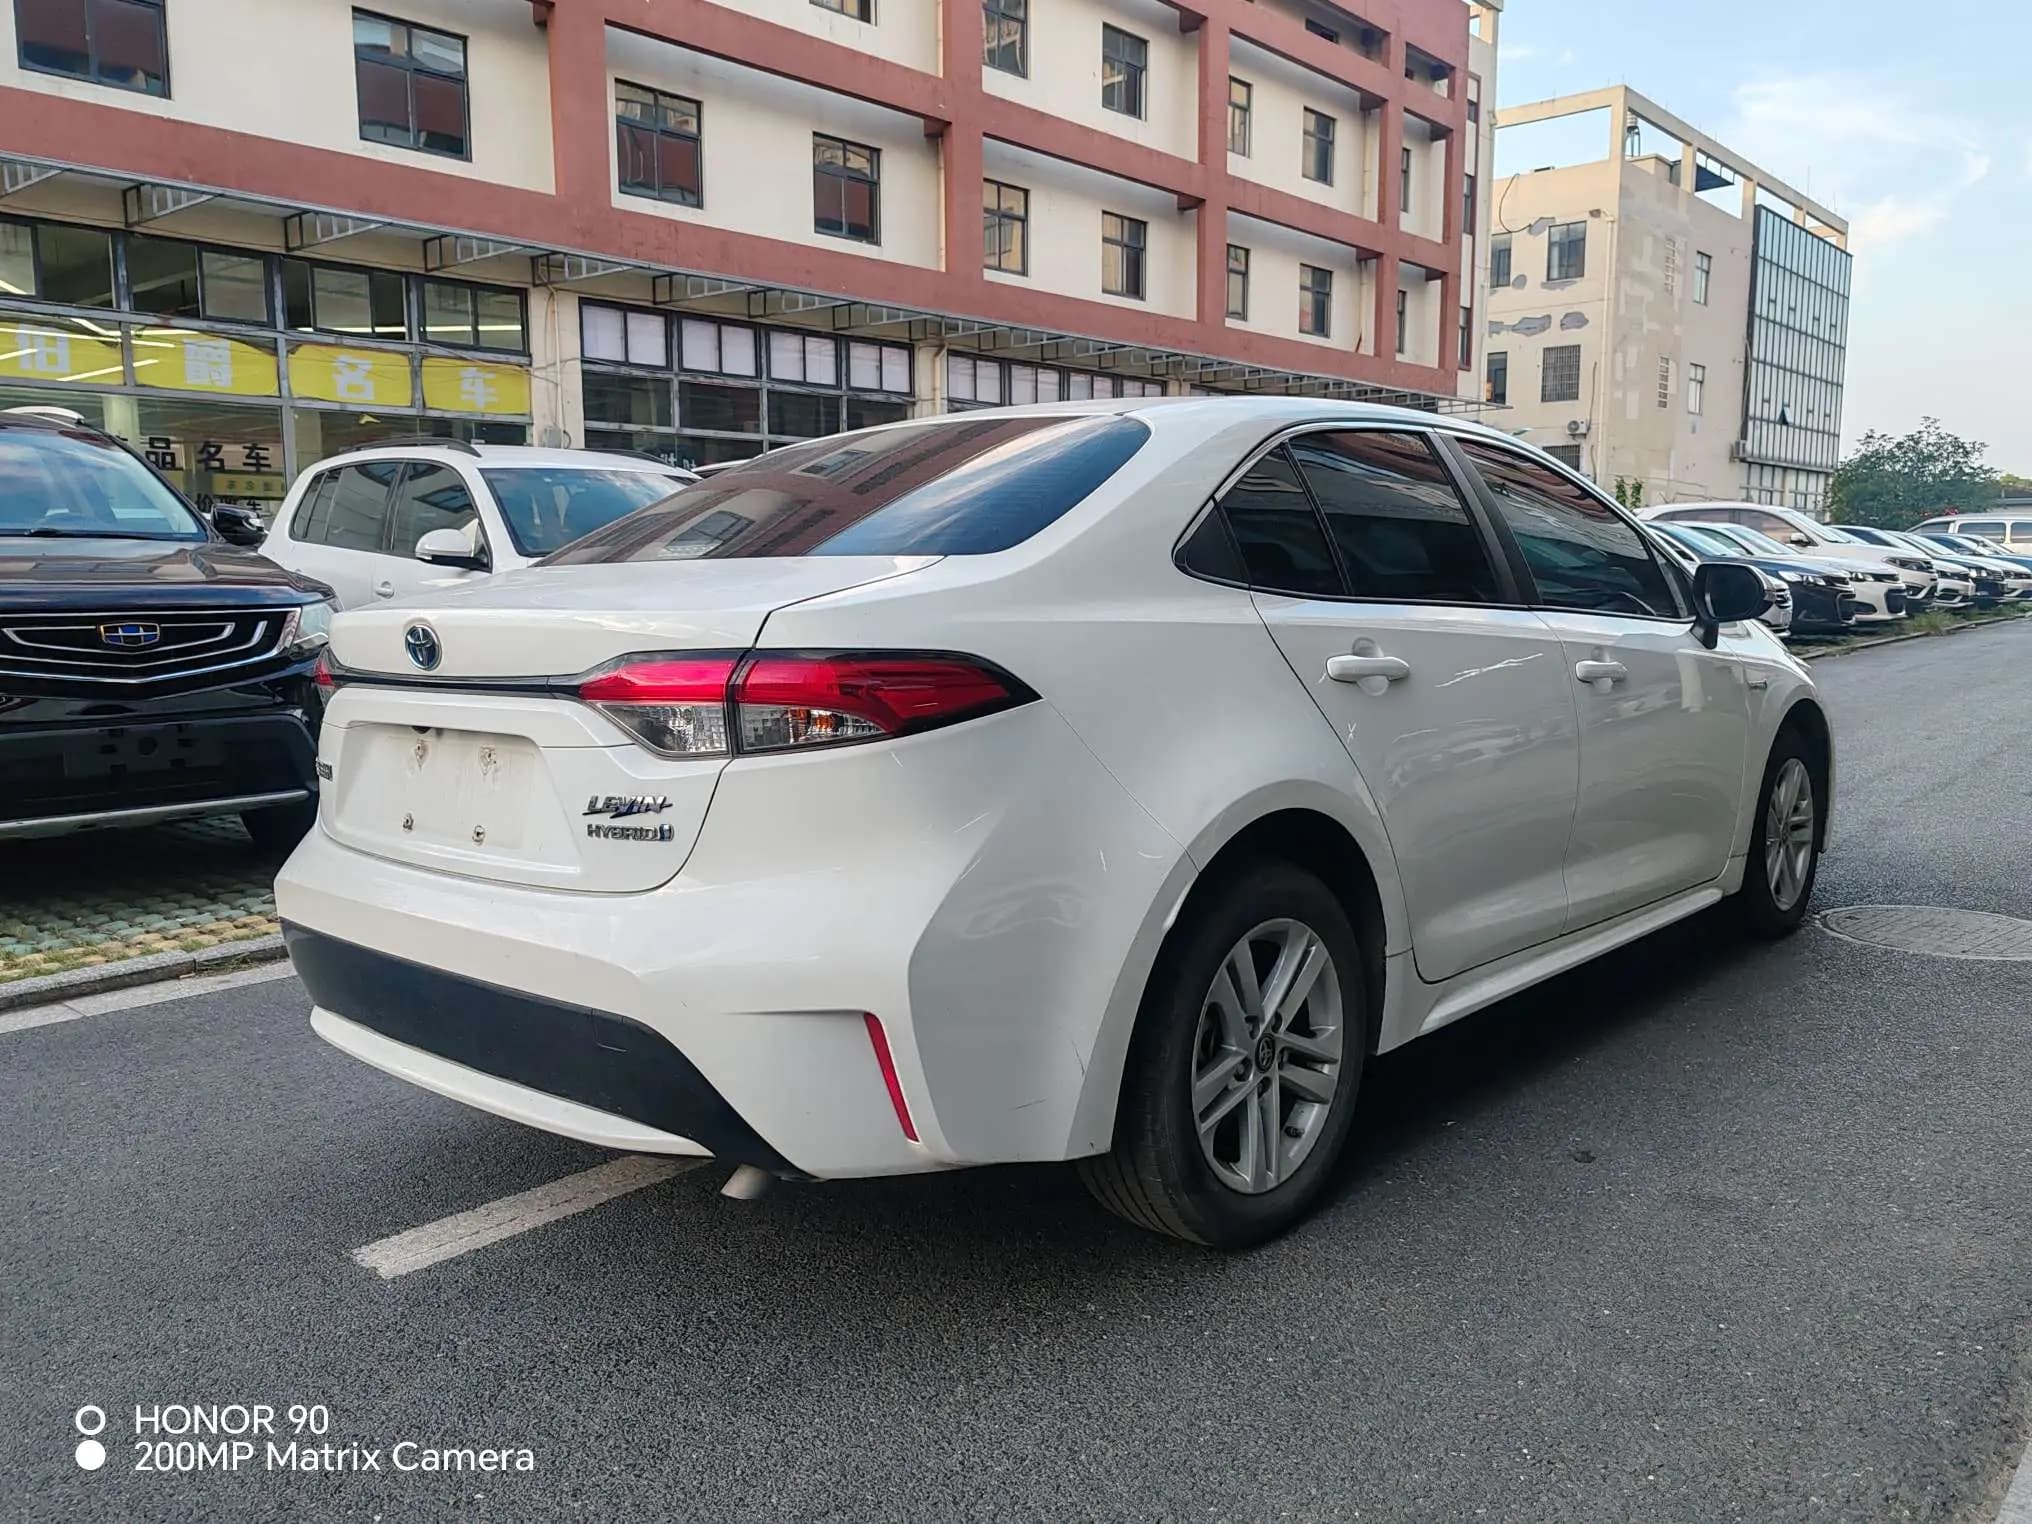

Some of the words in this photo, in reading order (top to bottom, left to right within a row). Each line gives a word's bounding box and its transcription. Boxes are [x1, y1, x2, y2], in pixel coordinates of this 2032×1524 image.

[116, 434, 272, 472] 品名车
[582, 796, 673, 819] LEVIN
[587, 823, 658, 841] HYBRID
